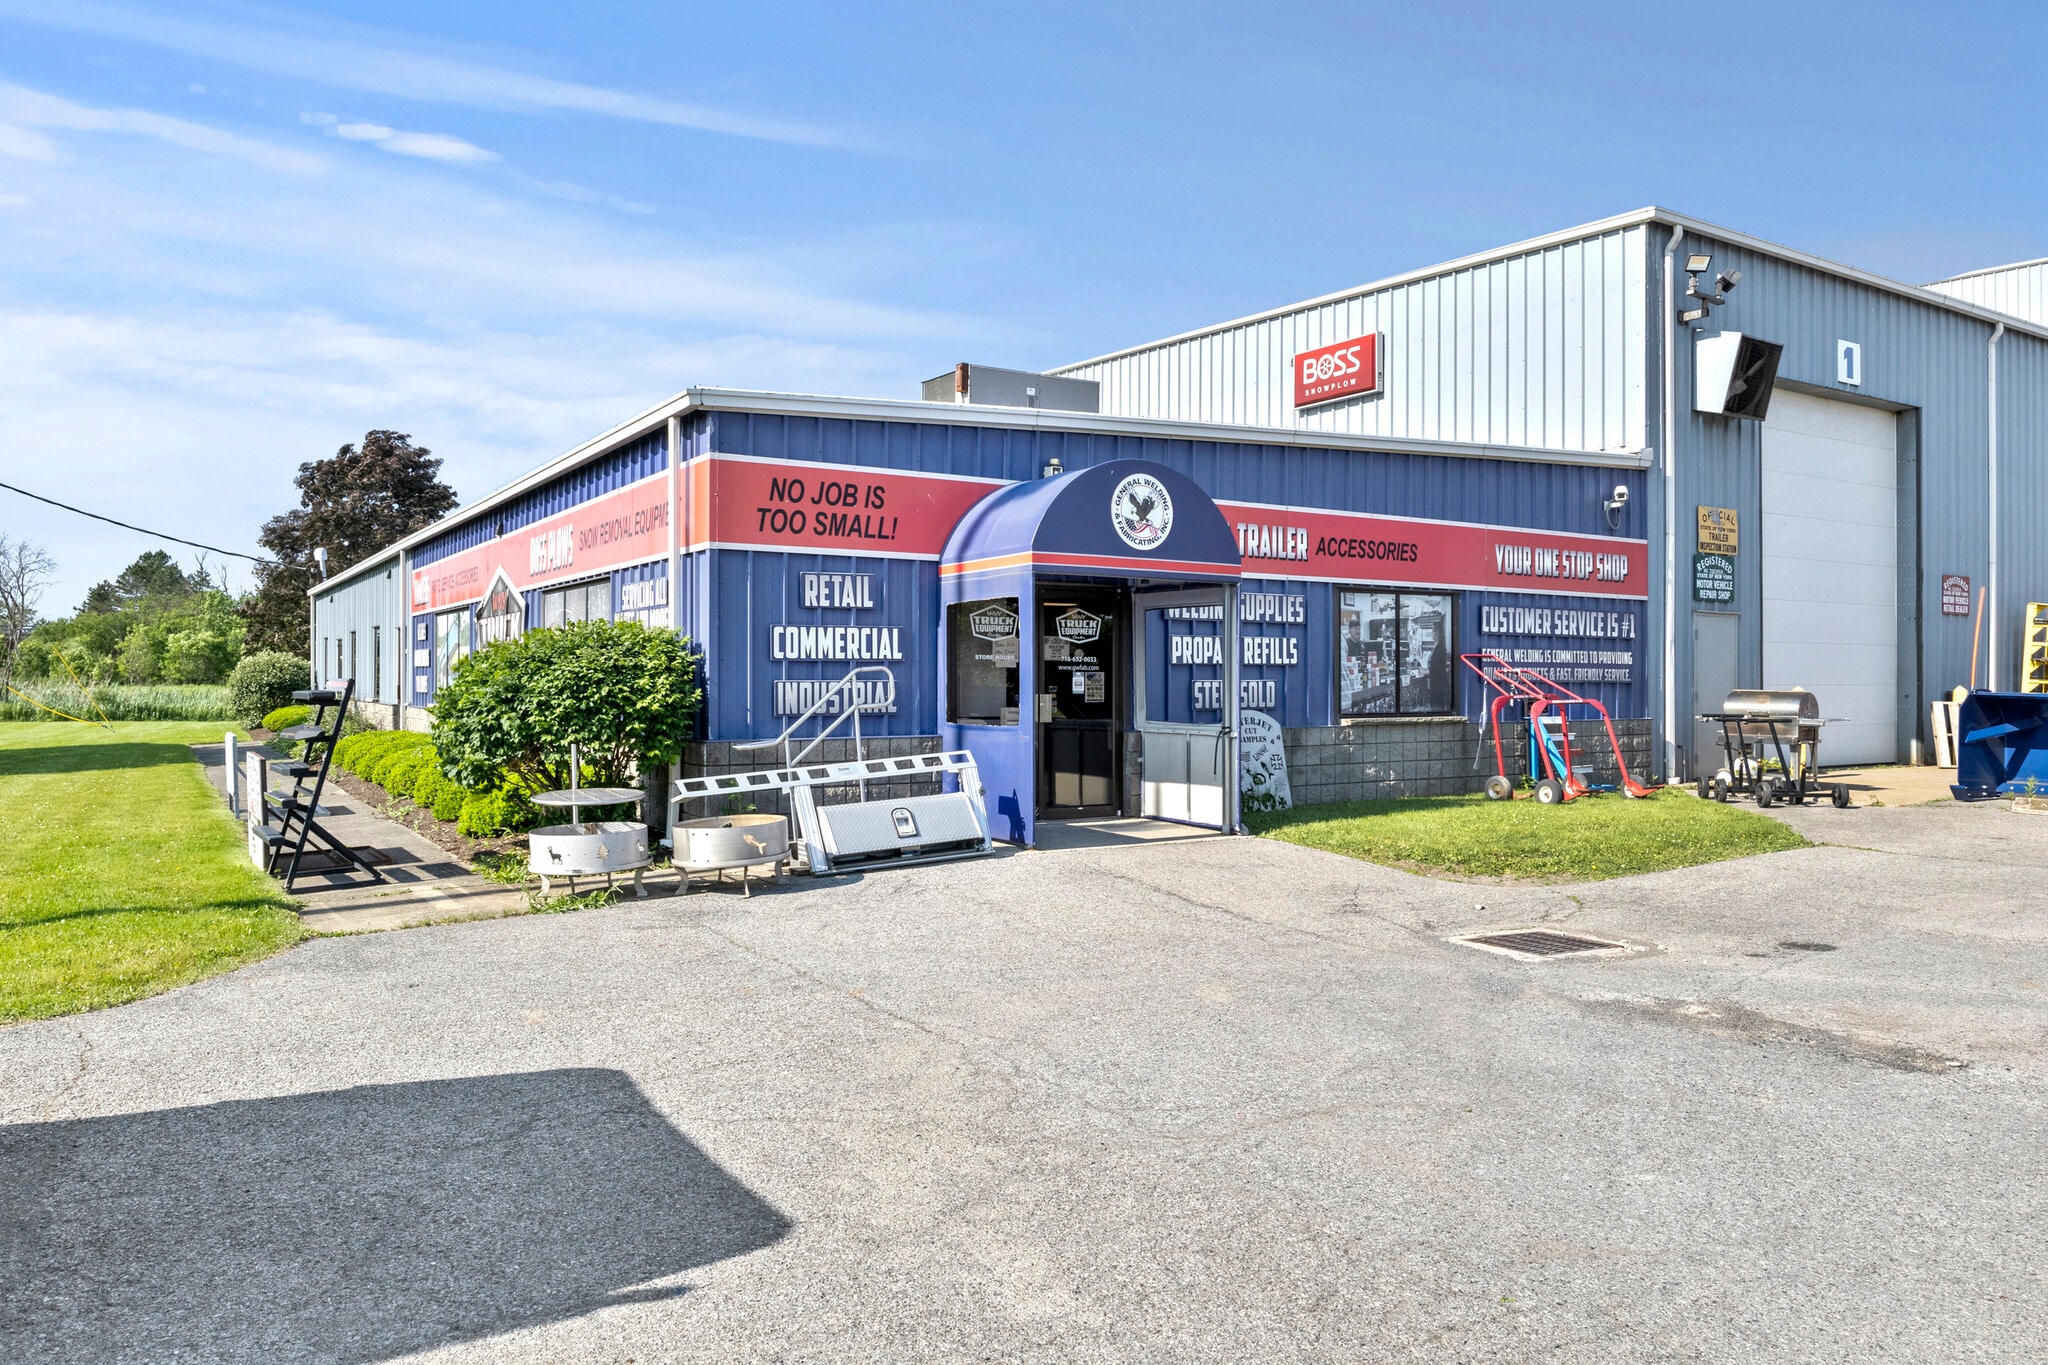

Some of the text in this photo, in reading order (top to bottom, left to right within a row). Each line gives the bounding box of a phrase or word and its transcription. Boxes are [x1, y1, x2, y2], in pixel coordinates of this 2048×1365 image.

[1303, 345, 1361, 385] BOSS
[1843, 346, 1854, 379] 1
[1305, 378, 1356, 396] SNOWPLOW
[769, 477, 885, 509] NO JOB IS
[1115, 478, 1142, 506] GENERAL
[1144, 478, 1170, 511] WELDING
[757, 508, 898, 540] TOO SMALL!
[1702, 510, 1736, 526] OFCIAL
[579, 525, 599, 551] SNOW
[599, 514, 632, 546] REMOVAL
[1237, 522, 1418, 562] TRAILER ACCESSORIES
[1708, 531, 1729, 543] TRAILER
[1700, 541, 1737, 554] INSPECTION STATION
[1495, 543, 1628, 582] YOUR ONE STOP SHOP
[1696, 556, 1733, 574] REGISTERED
[804, 574, 873, 608] RETAIL
[1696, 579, 1734, 590] MOTOR VEHICLE
[1699, 589, 1731, 600] REPAIR SHOP
[1943, 576, 1969, 591] REGISTERED
[974, 616, 1014, 625] TRUCK
[975, 624, 1013, 633] EQUIPMENT
[1060, 619, 1098, 628] TRUCK
[1061, 627, 1096, 635] EQUIPMENT
[1482, 605, 1635, 638] CUSTOMER SERVICE IS #1
[773, 626, 903, 660] COMMERCIAL
[1172, 636, 1298, 665] PROPA REFILLS
[1482, 648, 1632, 665] GENERAL WELDING IS COMMITTED TO PROVIDING
[1550, 668, 1556, 681] &
[1574, 668, 1603, 682] FRIENDLY
[777, 682, 897, 715] INDUSTRIAL
[1194, 681, 1276, 709] STE SOLD
